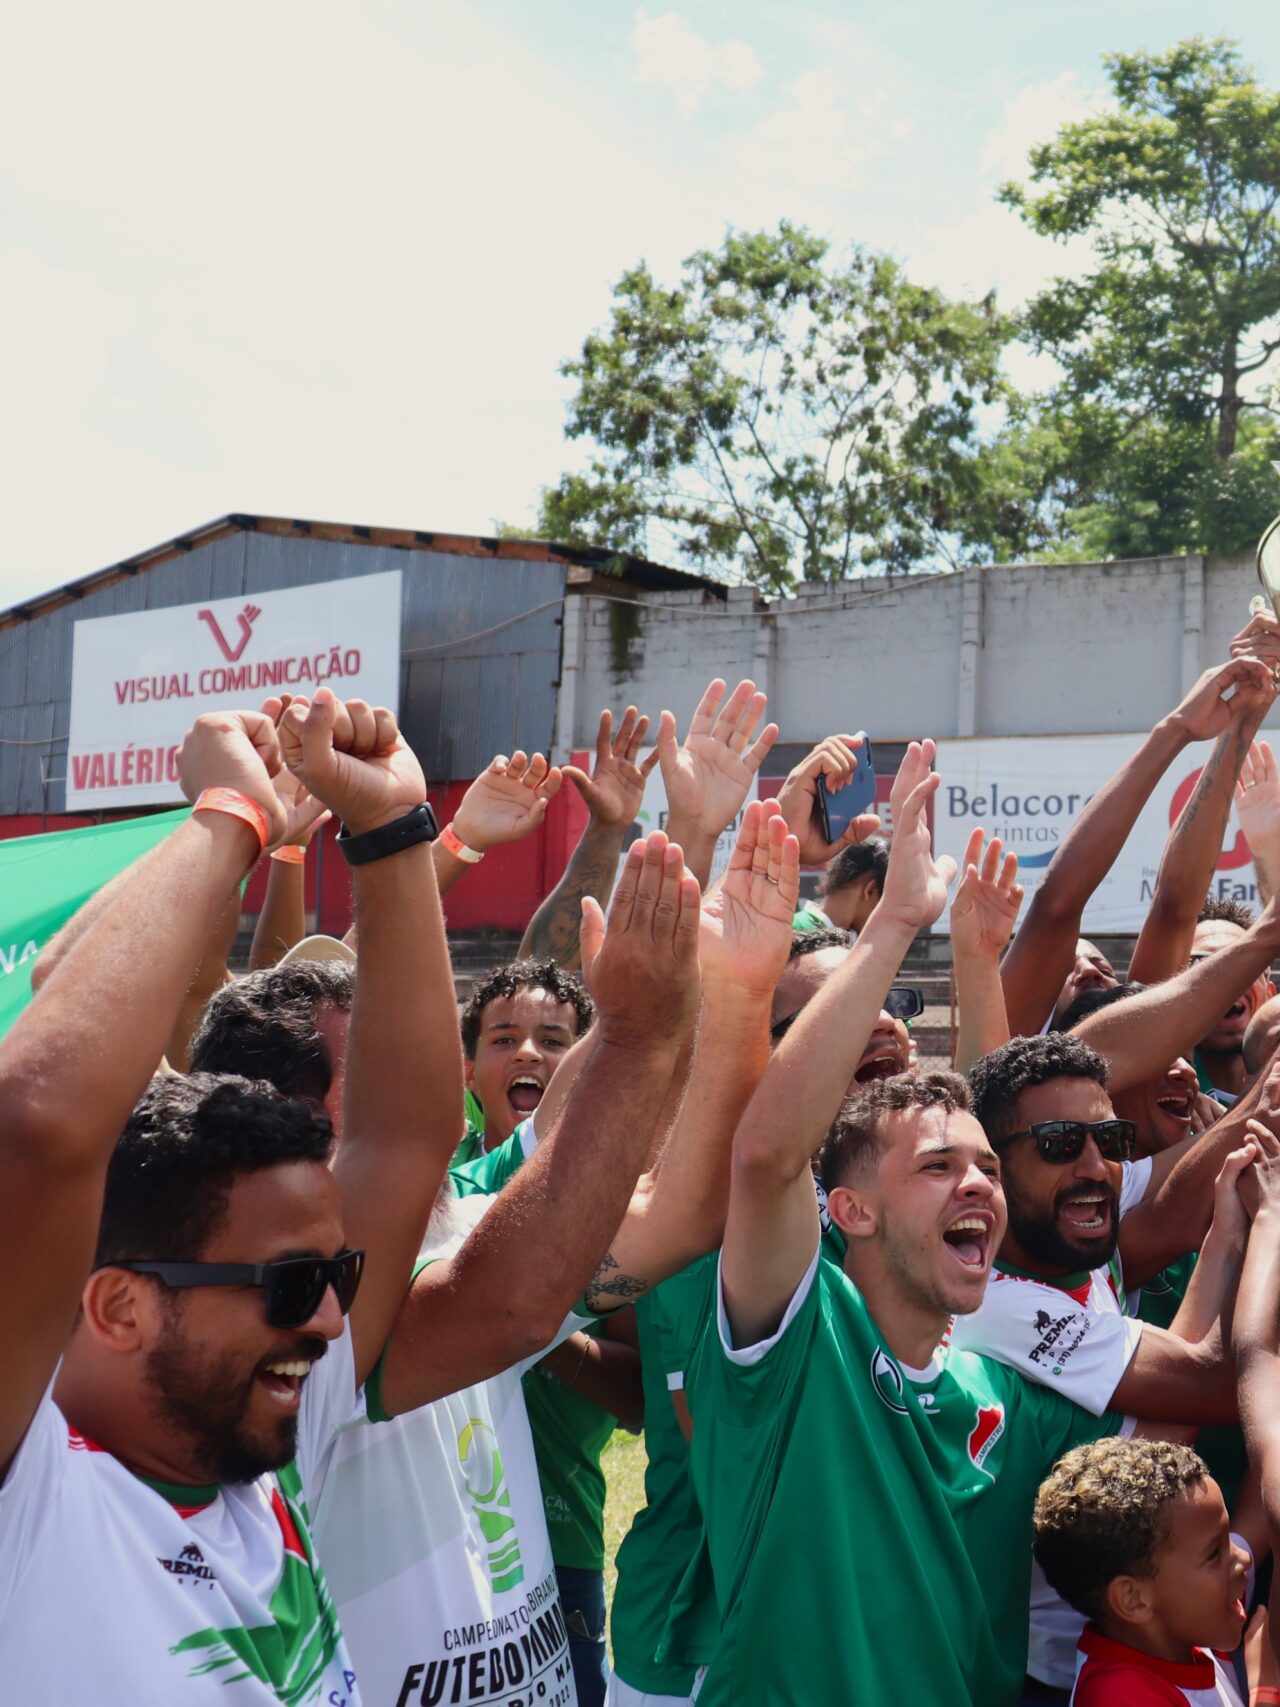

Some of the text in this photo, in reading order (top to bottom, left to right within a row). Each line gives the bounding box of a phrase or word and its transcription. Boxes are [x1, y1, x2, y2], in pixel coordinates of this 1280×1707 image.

[115, 645, 361, 705] VISUAL COMUNICAÇÃO
[946, 783, 1094, 818] Belacor
[994, 821, 1059, 843] tintas
[444, 1605, 529, 1651] CAMPEONATO
